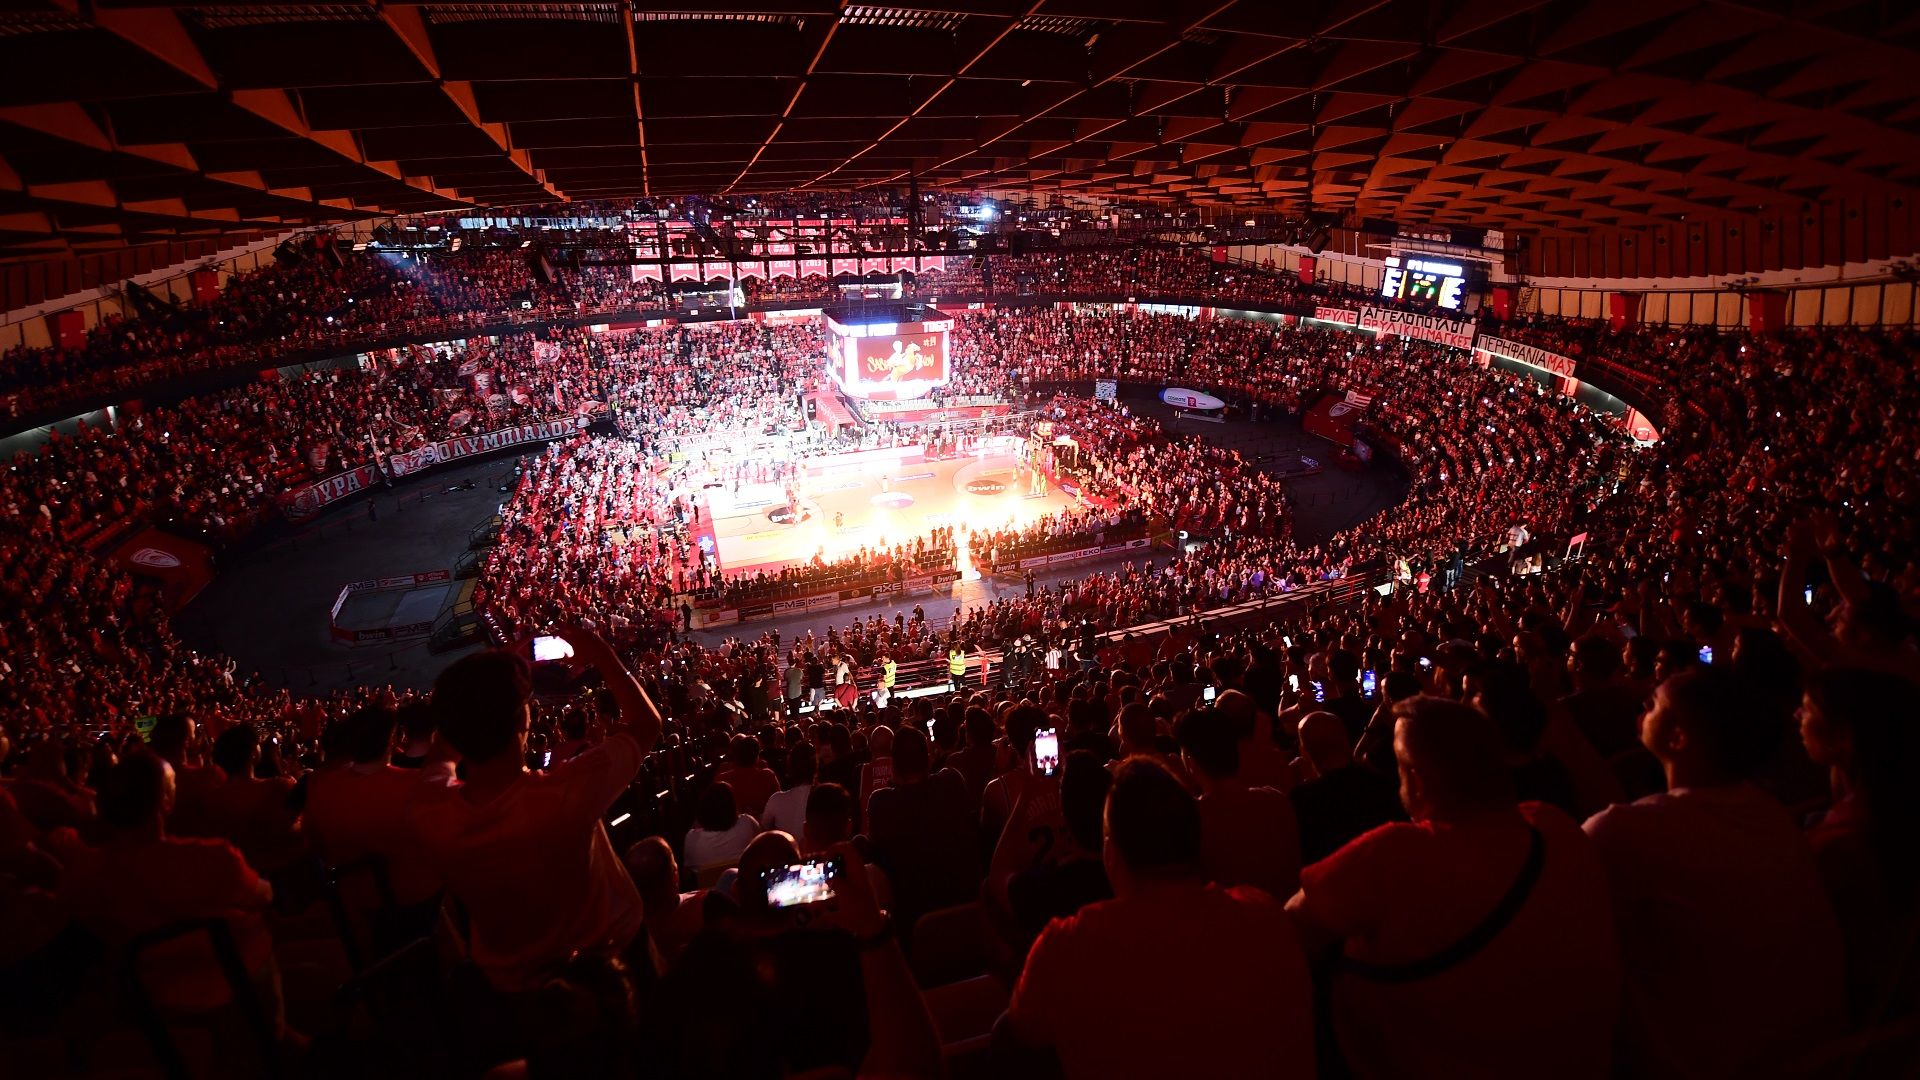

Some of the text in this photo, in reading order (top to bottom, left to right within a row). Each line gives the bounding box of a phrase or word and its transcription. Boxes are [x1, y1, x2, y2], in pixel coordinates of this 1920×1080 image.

[1363, 307, 1465, 334] ΑΓΓΕΛΟΠΟΥΛΟΙ
[438, 419, 576, 460] ΟΛΥΜΠΙΑΚΟΣ
[996, 563, 1016, 573] bwin
[936, 574, 958, 584] bwin
[873, 582, 902, 594] AXE
[774, 599, 806, 610] FMS
[358, 630, 386, 642] bwin
